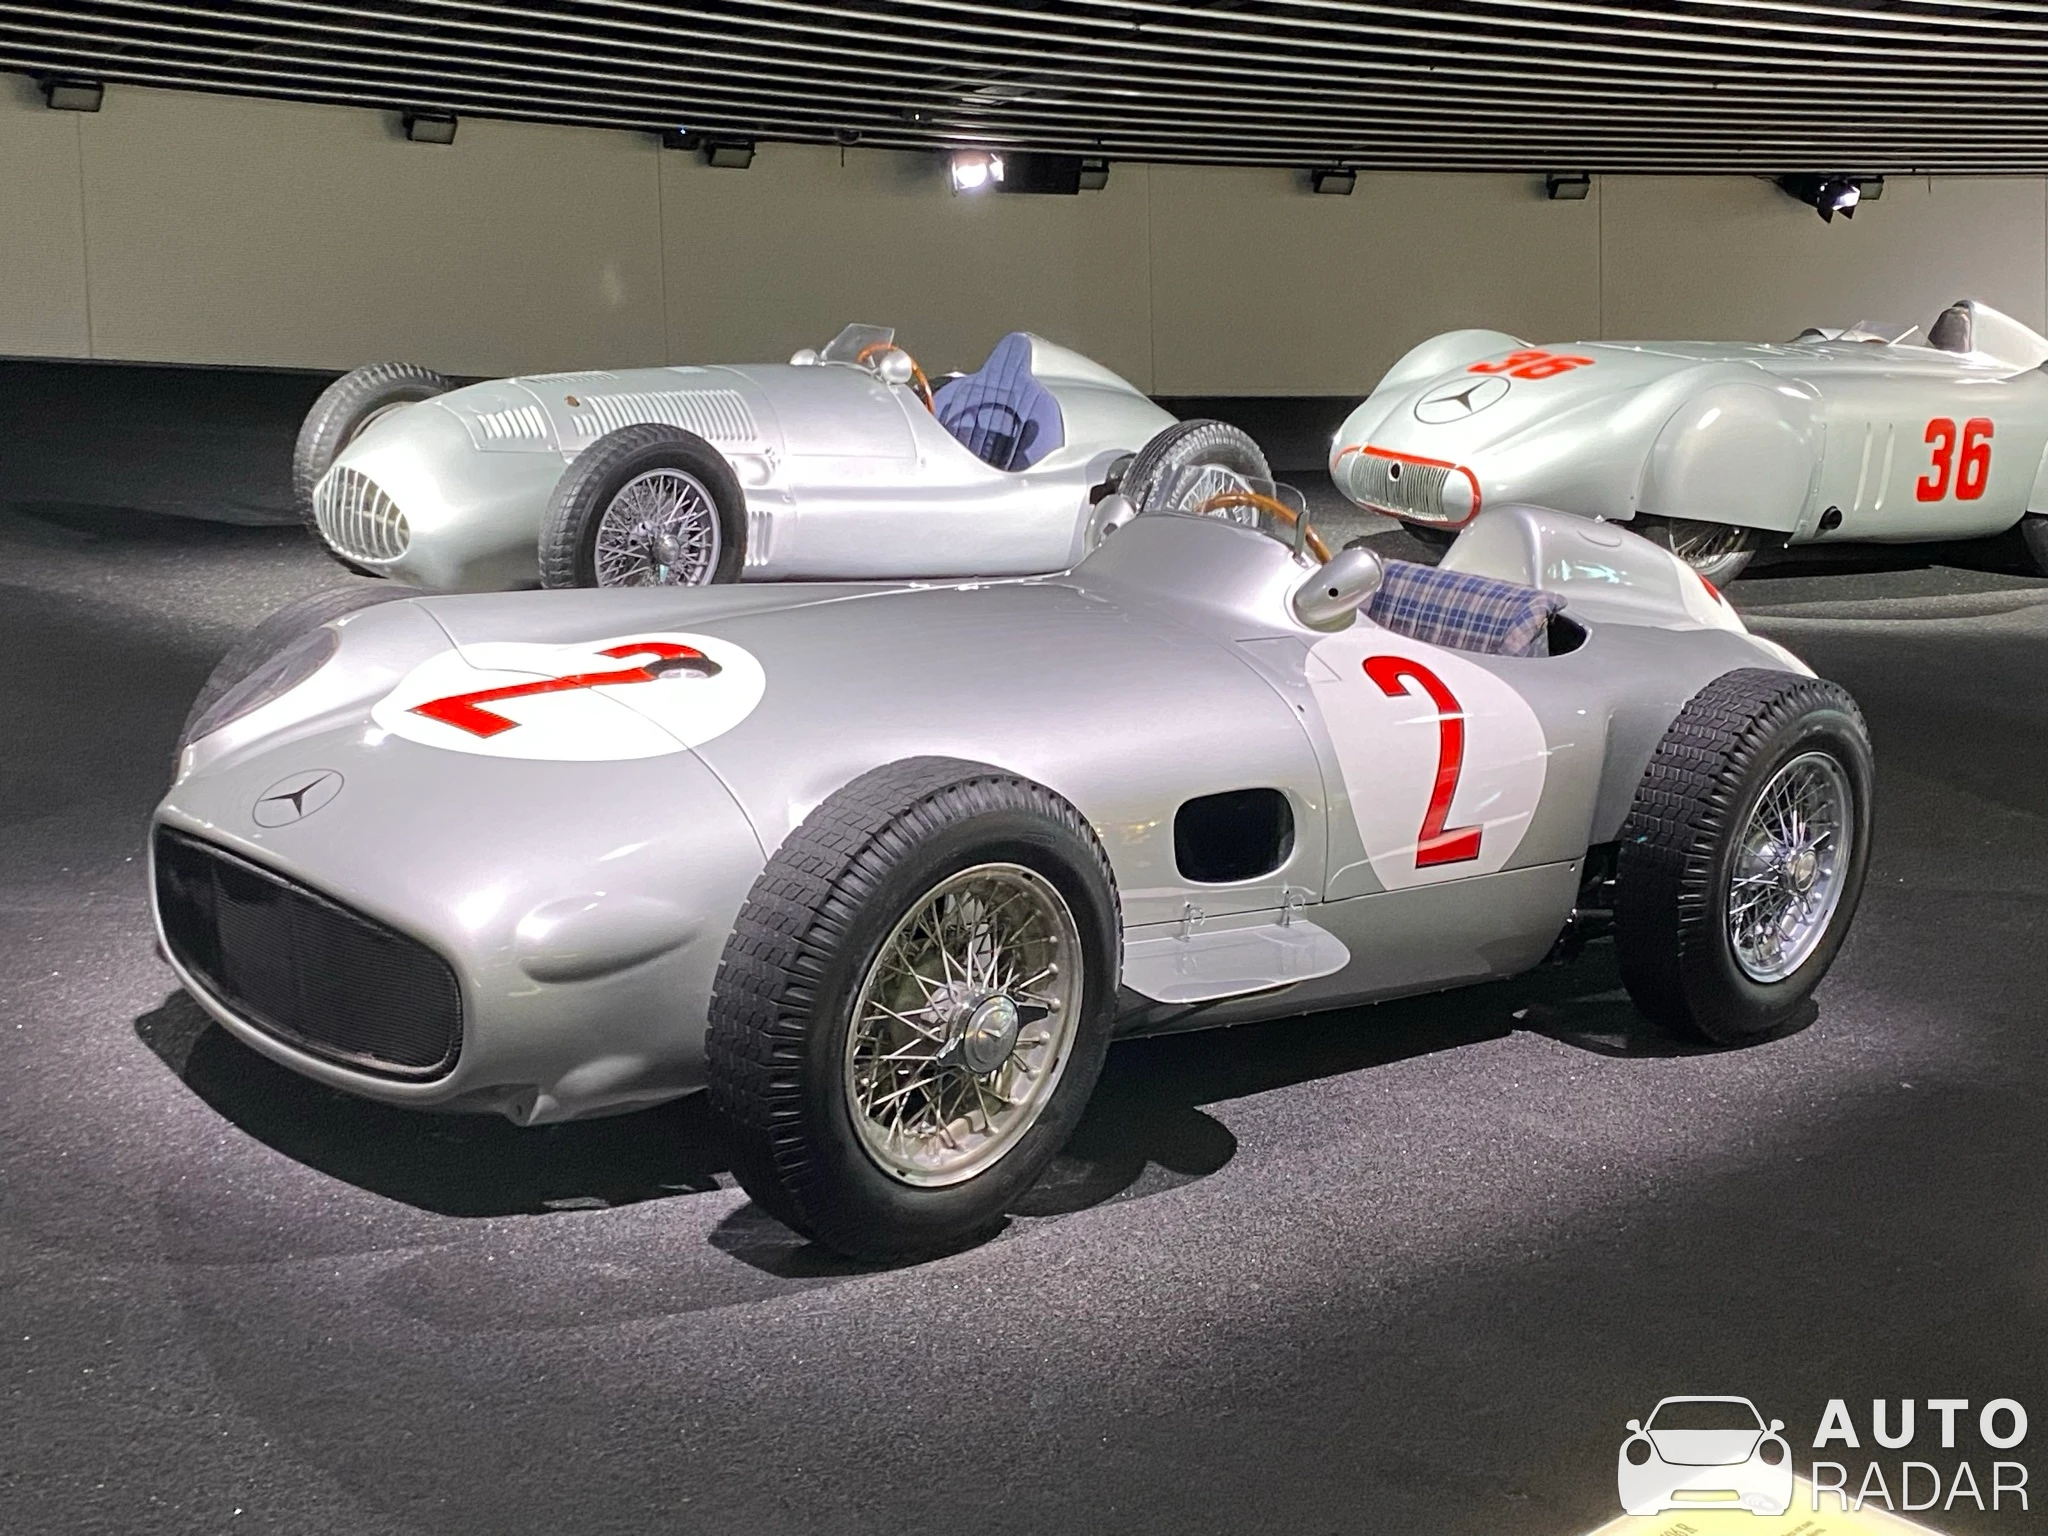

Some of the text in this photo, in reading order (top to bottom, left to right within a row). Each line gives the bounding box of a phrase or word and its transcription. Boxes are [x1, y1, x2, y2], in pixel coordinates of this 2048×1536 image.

[1468, 350, 1596, 381] 36
[1915, 417, 1996, 503] 36
[406, 642, 706, 739] 2
[1362, 655, 1483, 869] 2
